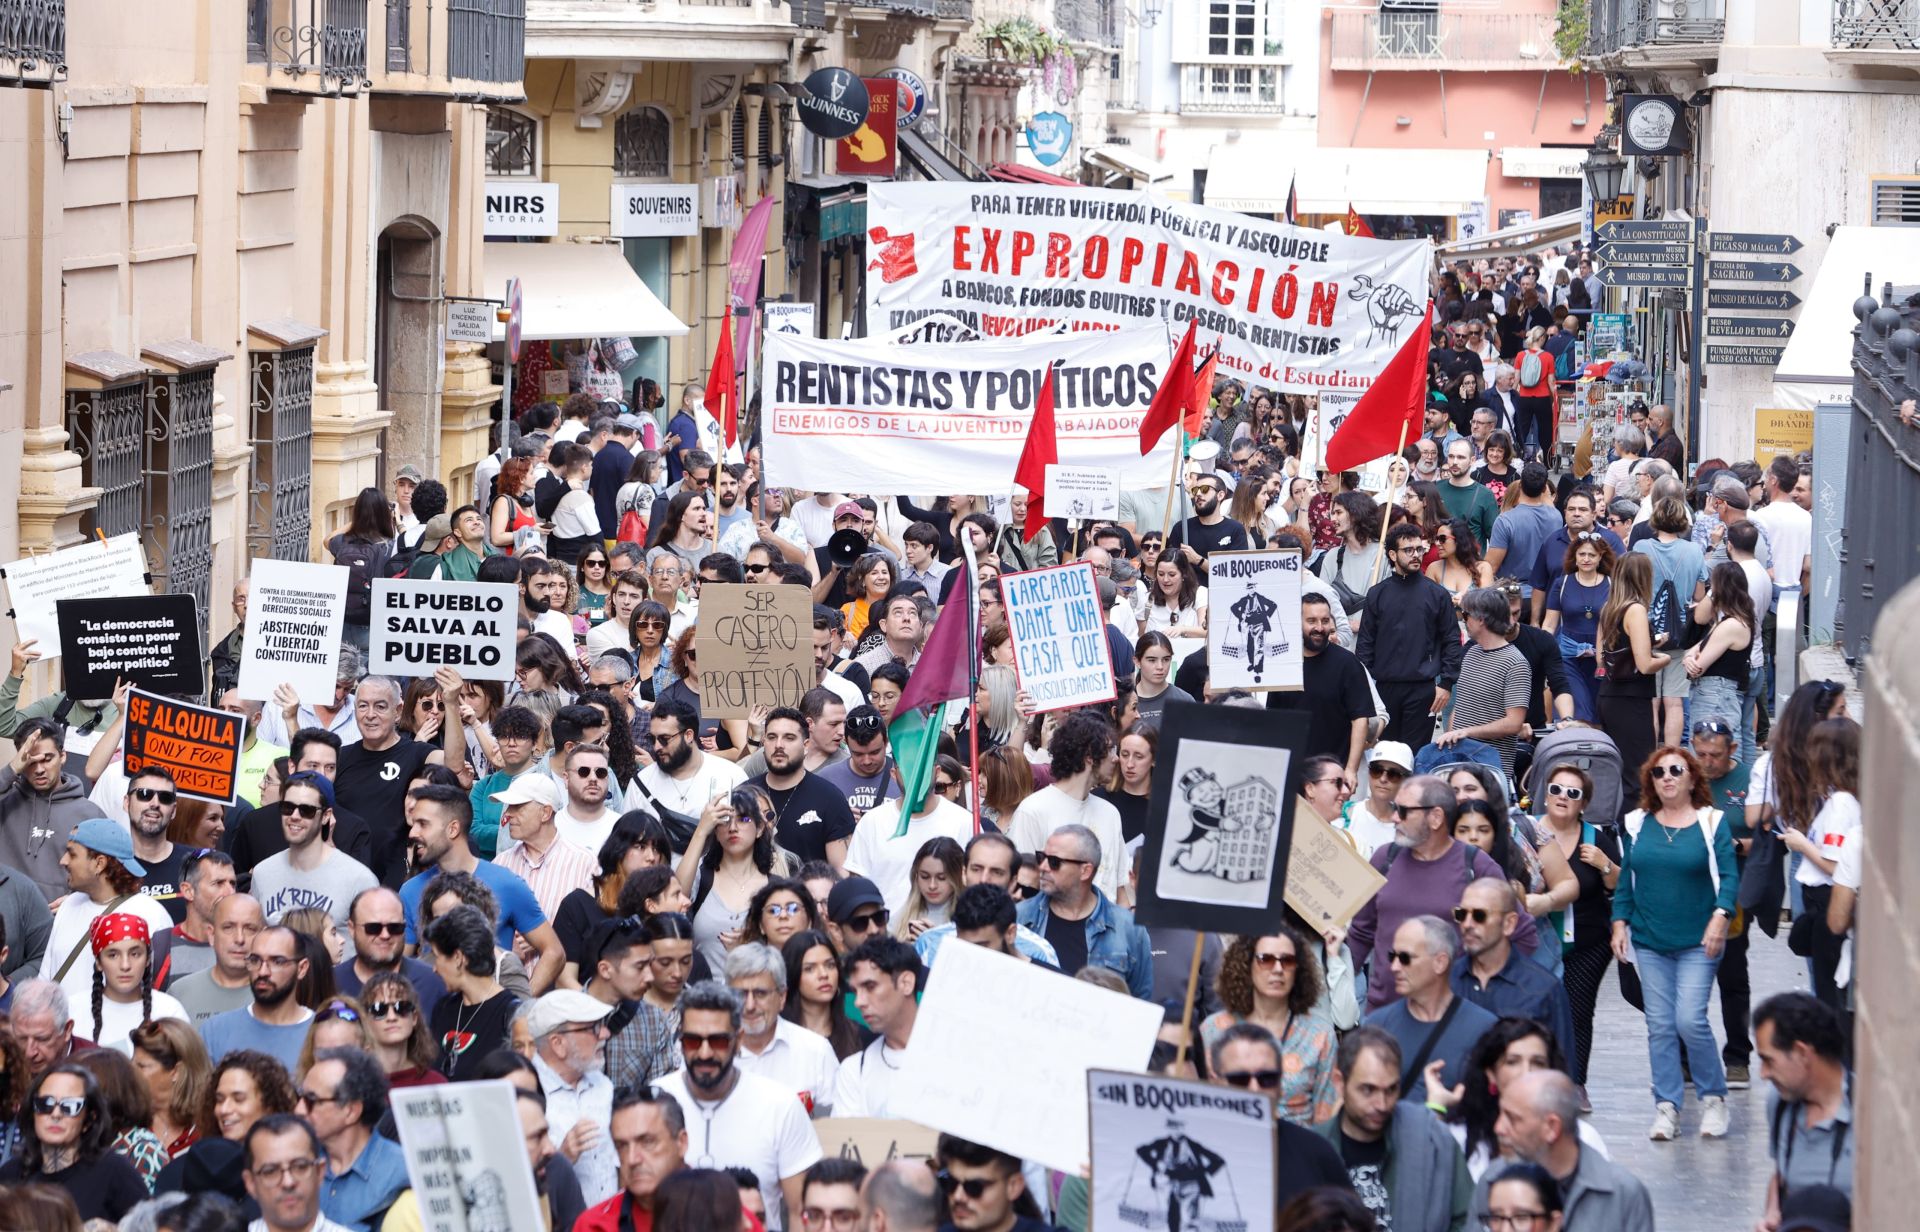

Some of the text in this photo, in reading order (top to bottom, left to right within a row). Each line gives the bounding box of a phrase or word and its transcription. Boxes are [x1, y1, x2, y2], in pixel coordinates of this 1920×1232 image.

[801, 97, 861, 125] GUINNESS
[486, 195, 545, 214] NIRS
[629, 197, 692, 215] SOUVENIRS
[1597, 202, 1634, 216] ATM
[488, 215, 545, 223] CTORIA
[659, 215, 692, 224] VICTORIA
[971, 194, 1330, 263] PARA TENER VIVIENDA PÚBLICA Y ASEQUIBLE
[1621, 229, 1687, 240] LA CONSTITUCIÓN
[1665, 246, 1686, 254] MUSEO
[1714, 241, 1778, 252] PICASSO MÁLAGA
[1618, 253, 1686, 262] CARMEN THYSSEN
[953, 225, 1339, 328] EXPROPIACIÓN
[1626, 272, 1685, 282] MUSEO DEL VINO
[1712, 269, 1754, 280] SAGRARIO
[1710, 293, 1778, 305] MUSEO DE MÁLAGA
[451, 313, 487, 322] ENCENDIDA
[890, 310, 979, 337] IZQDA
[942, 279, 1341, 356] A BANCOS, FONDOS BUITRES Y CASEROS RENTISTAS
[451, 328, 486, 338] VEHÍCULOS
[1710, 326, 1777, 336] REVELLO DE TORO
[1710, 346, 1777, 356] FUNDACIÓN PICASSO
[1710, 355, 1774, 364] MUSEO CASA NATAL
[776, 359, 1158, 410] RENTISTAS Y POLÍTICOS
[1284, 366, 1378, 388] Estudian
[1322, 394, 1363, 405] SIN BOQUERONE
[778, 414, 1140, 433] ENEMIGOS DE LA JUVENTUD ABAJADOR
[1212, 555, 1298, 579] SIN BOQUERONES
[259, 587, 280, 595] CONTRA
[286, 589, 337, 600] DESMANTELAMIENTO
[1009, 569, 1092, 606] ¡ARCARDE
[308, 599, 316, 607] DE
[316, 600, 327, 608] LOS
[386, 592, 504, 613] EL PUEBLO
[744, 590, 778, 611] SER
[262, 603, 332, 618] DERECHOS SOCIALES
[80, 616, 174, 632] "La democracia
[258, 620, 328, 637] ¡ABSTENCIÓN!
[387, 616, 501, 637] SALVA AL
[1014, 598, 1098, 642] DAME UNA
[77, 632, 181, 645] consiste en poner
[715, 613, 798, 651] CASERO
[88, 643, 172, 659] bajo control al
[265, 635, 320, 651] Y LIBERTAD
[255, 648, 328, 665] CONSTITUYENTE
[385, 641, 501, 666] PUEBLO
[1020, 633, 1105, 677] CASA QUE
[88, 656, 175, 673] poder político"
[129, 696, 236, 746] SE ALQUILA
[150, 737, 224, 767] ONLY FOR
[855, 786, 877, 795] STAY
[266, 887, 287, 918] UK
[1097, 1083, 1265, 1121] SIN BOQUERONES
[423, 1172, 450, 1190] MÁS
[430, 1197, 452, 1216] QUE
